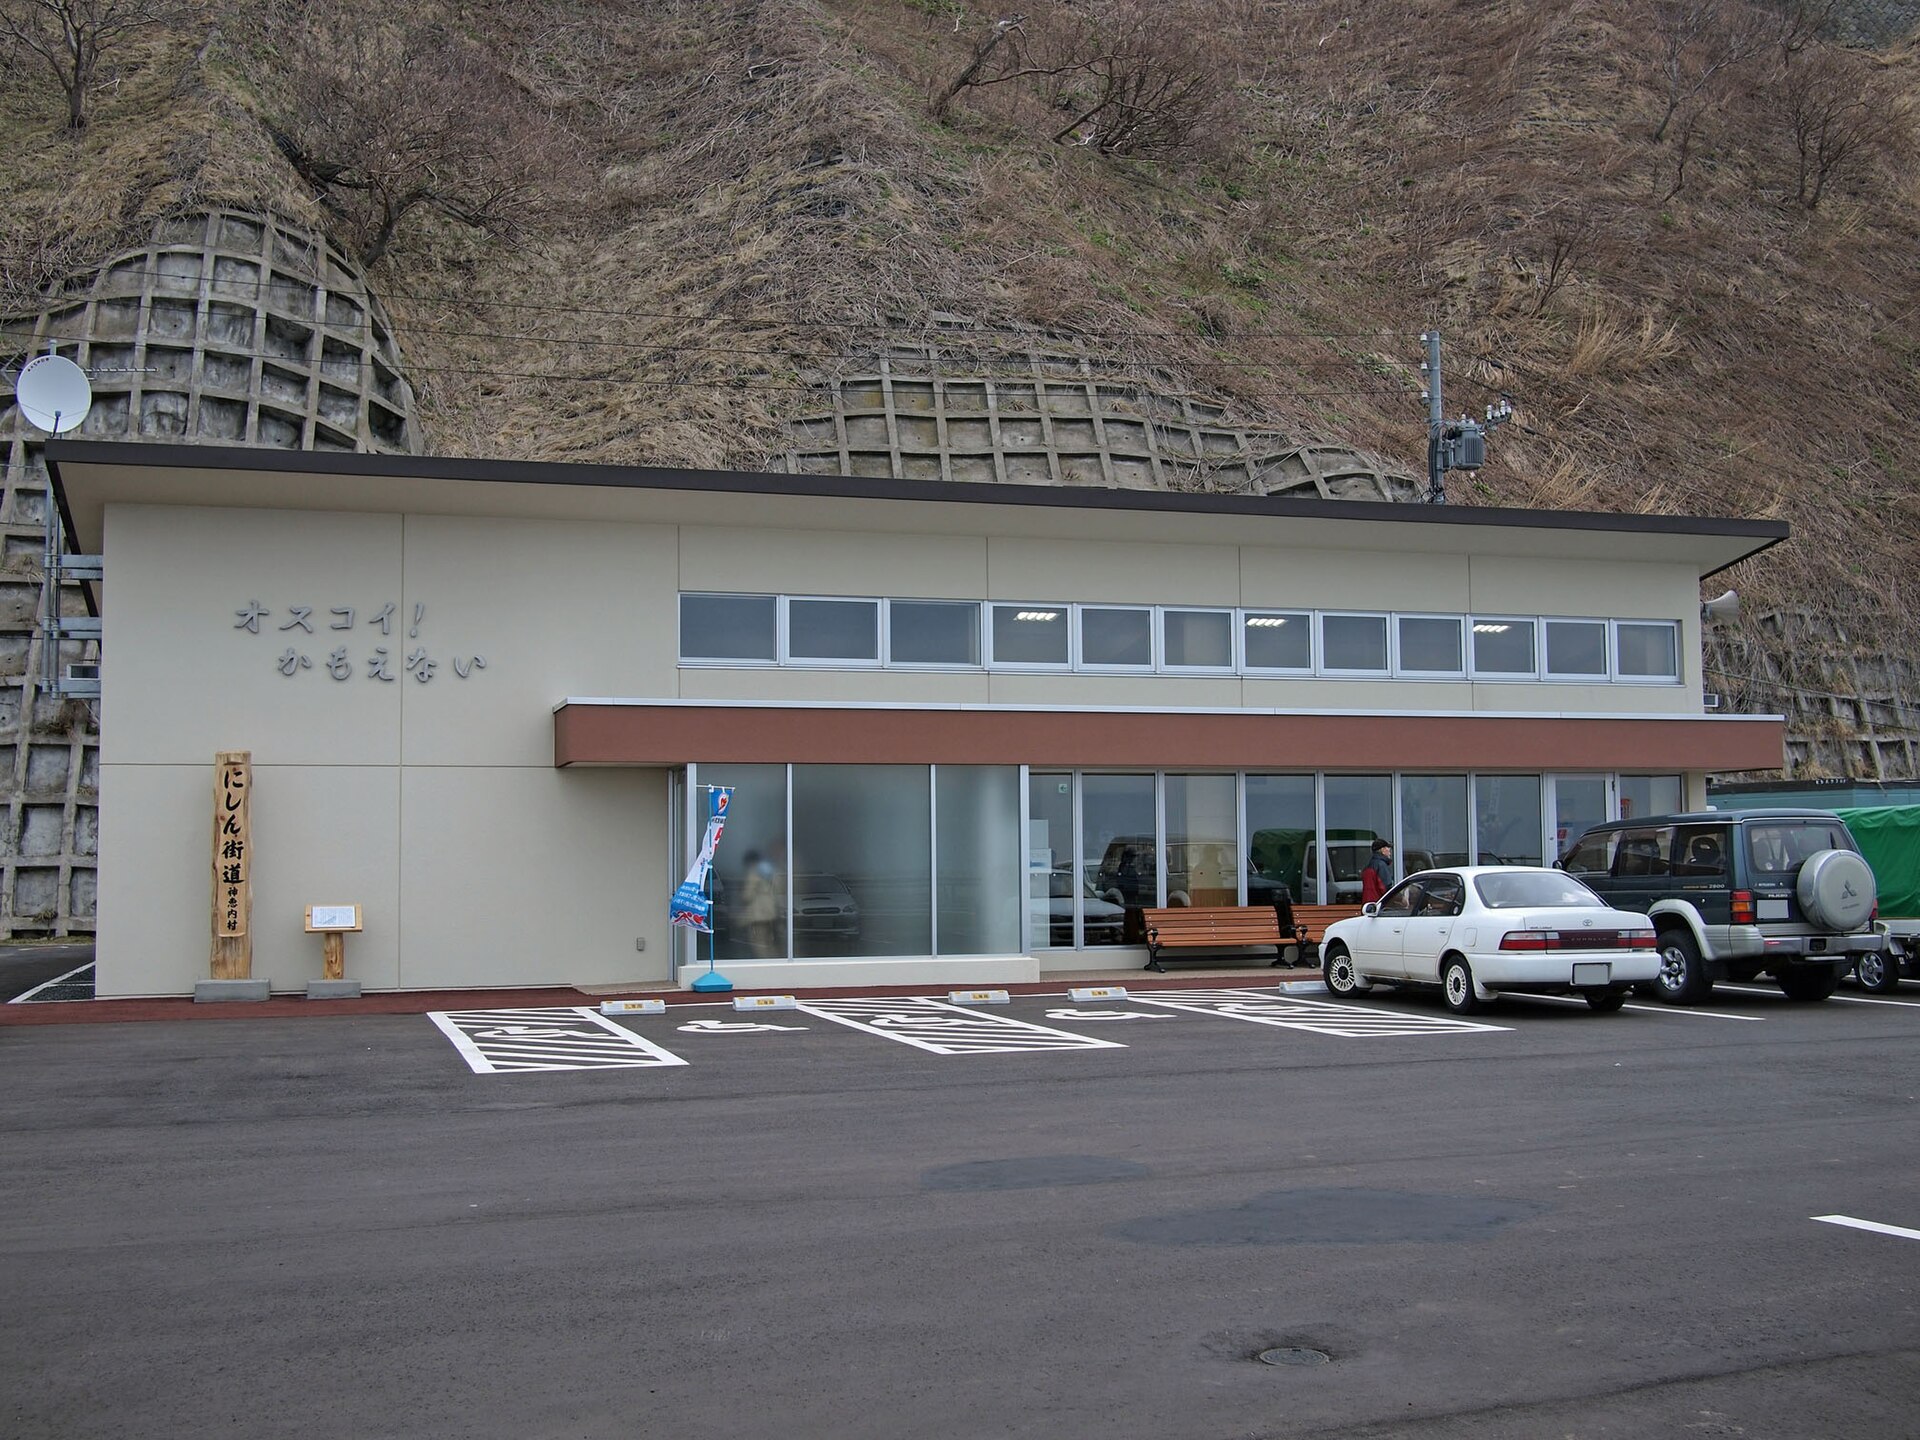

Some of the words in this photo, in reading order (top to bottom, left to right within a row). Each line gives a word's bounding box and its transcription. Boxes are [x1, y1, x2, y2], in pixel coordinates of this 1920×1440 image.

[278, 648, 487, 683] かもえない
[222, 769, 245, 884] にしん街道
